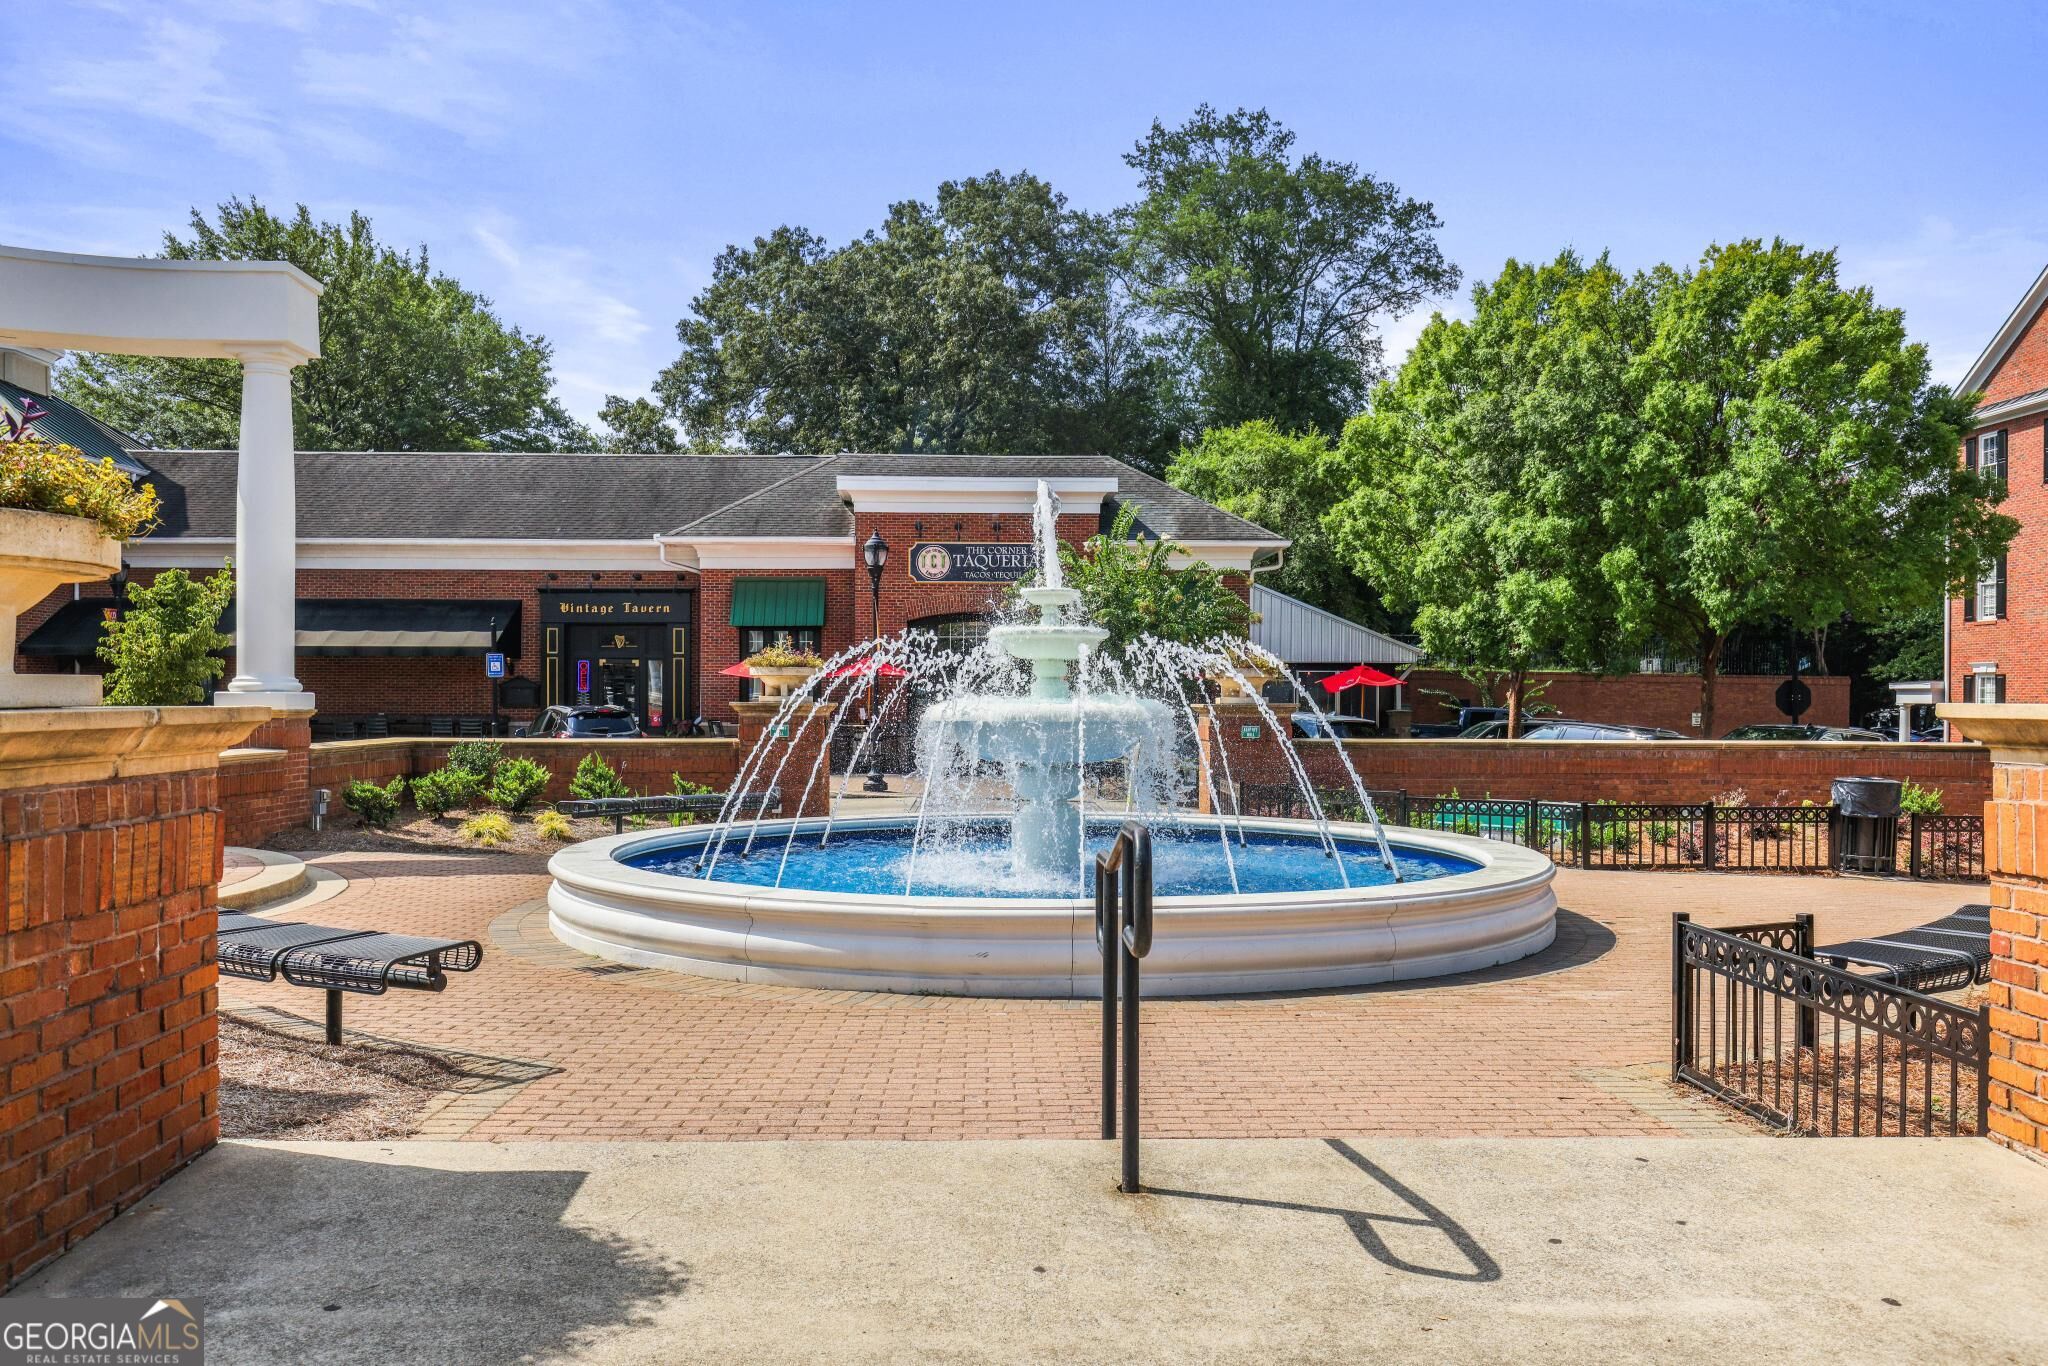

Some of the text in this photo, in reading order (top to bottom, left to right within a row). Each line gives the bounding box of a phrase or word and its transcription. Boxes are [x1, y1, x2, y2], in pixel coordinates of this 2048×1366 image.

[966, 546, 1027, 554] THE CORNER
[560, 602, 671, 615] Vintage Tavern
